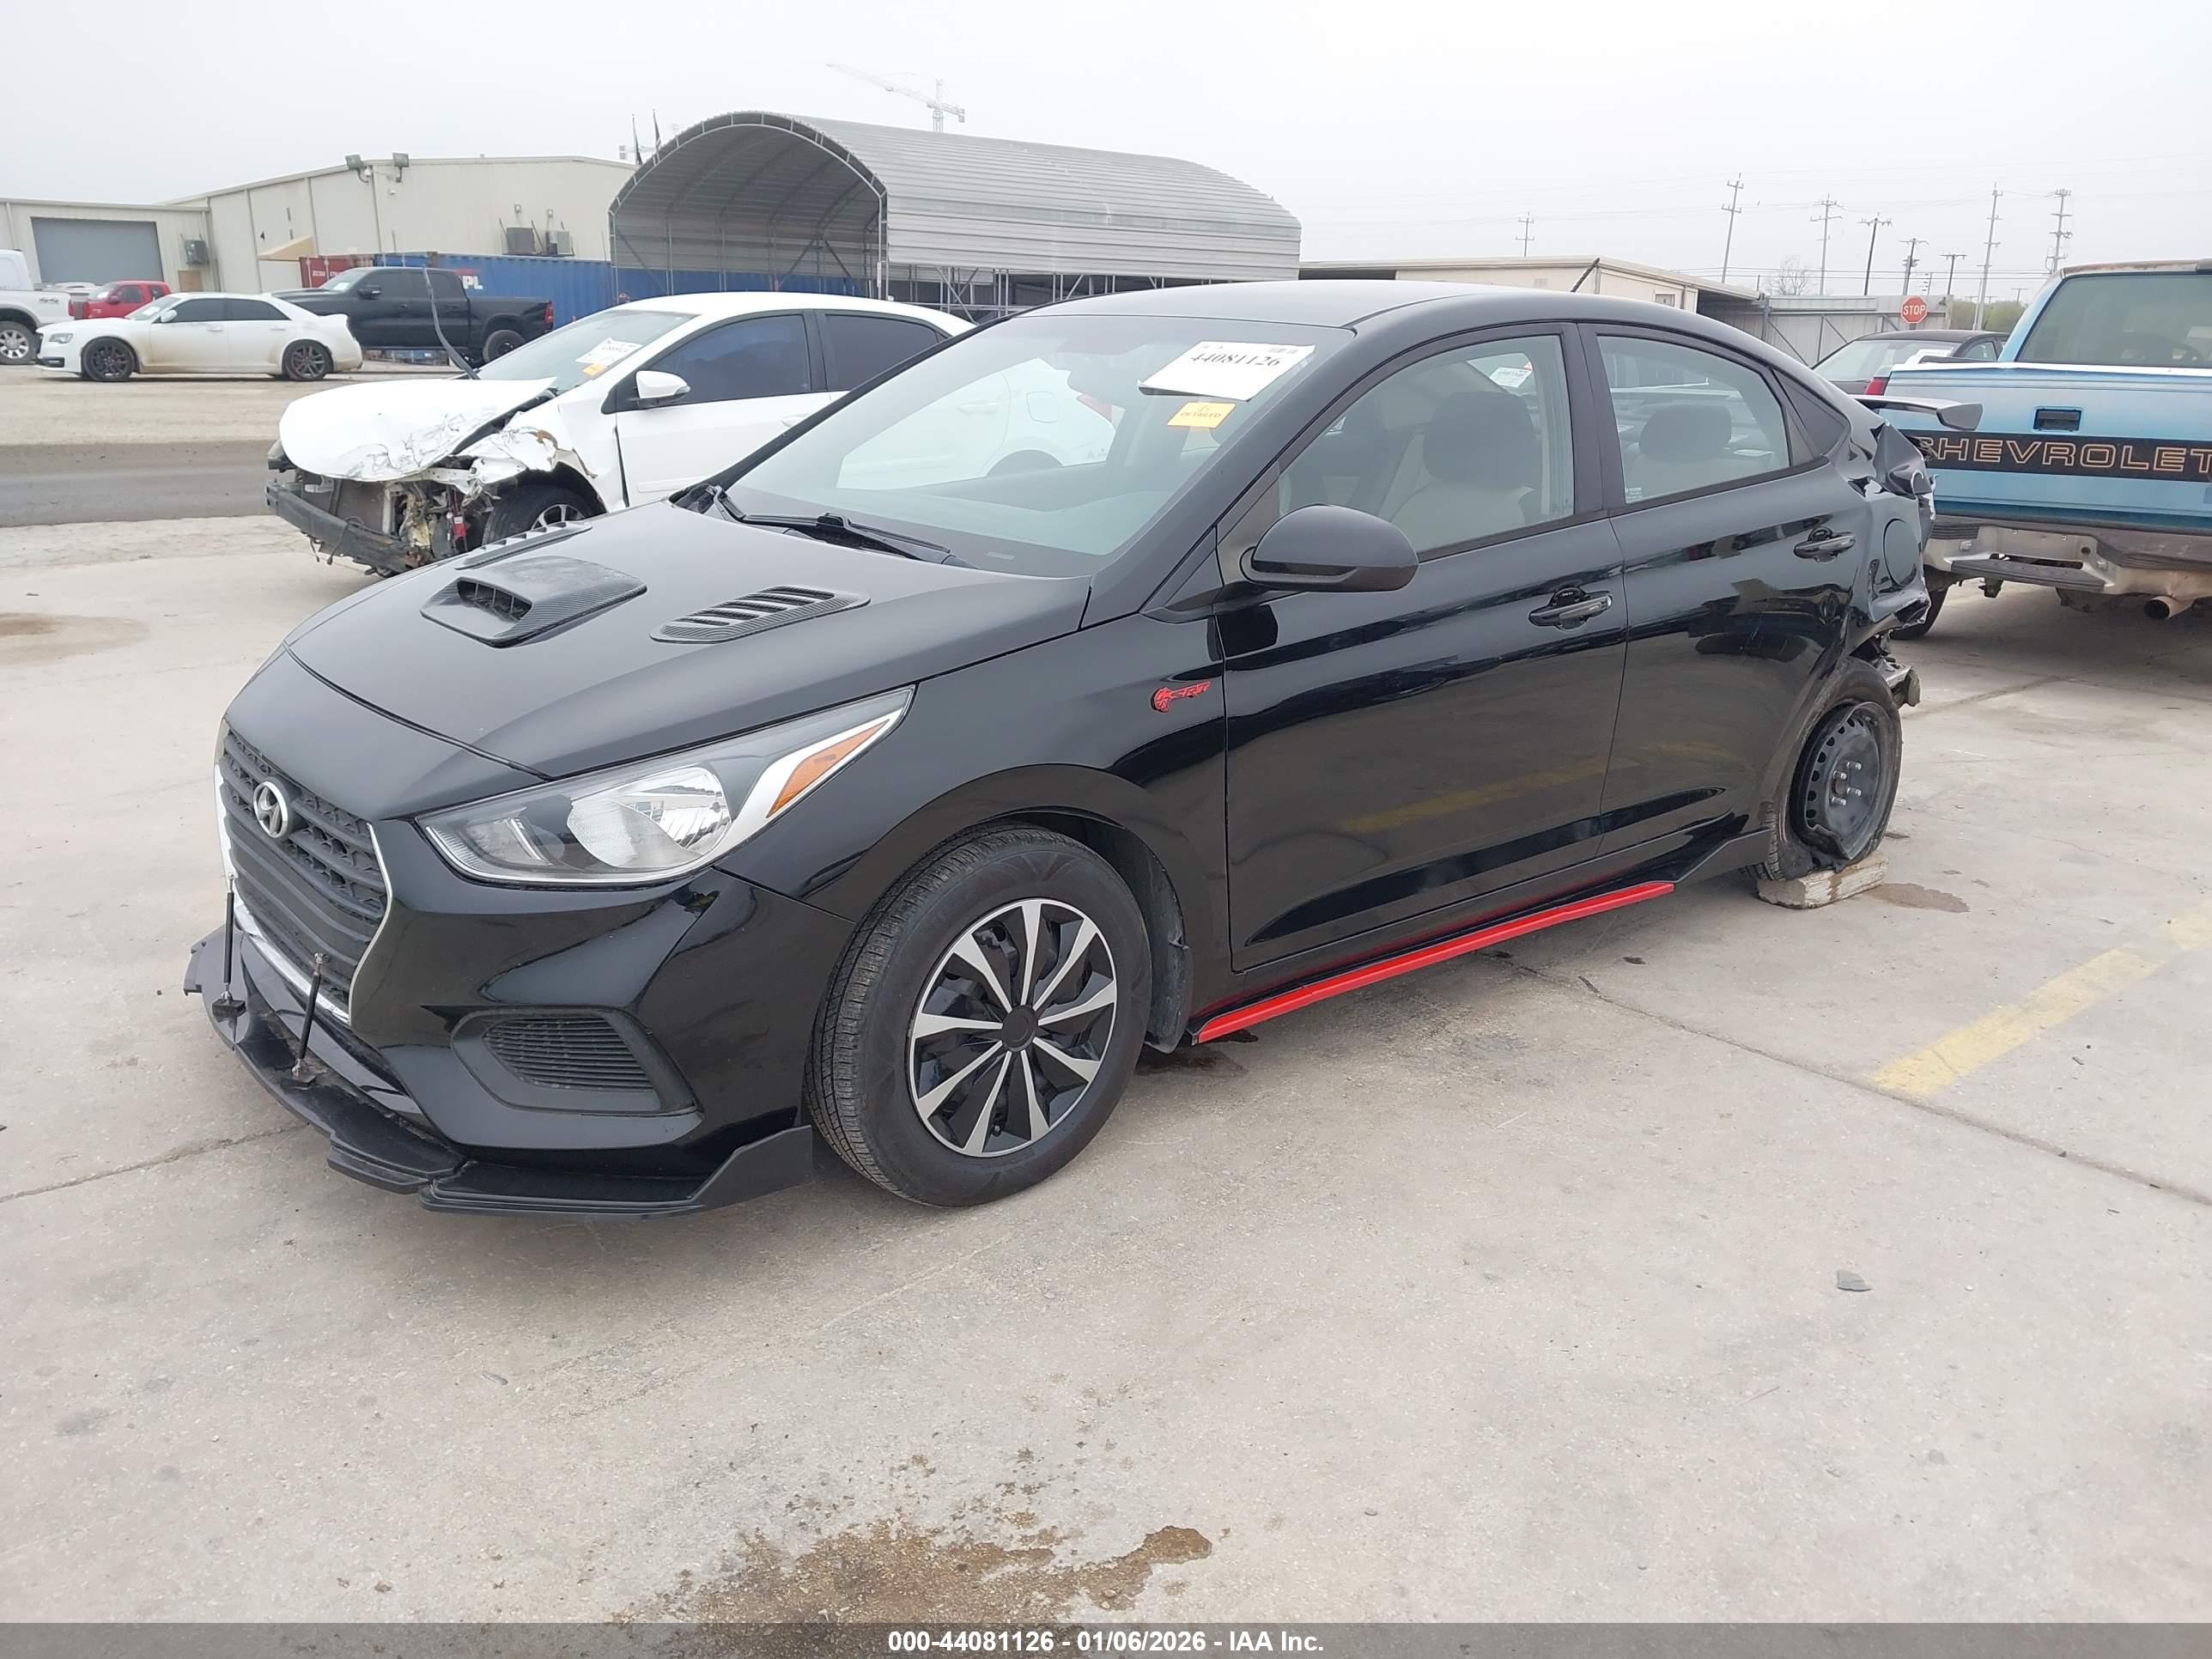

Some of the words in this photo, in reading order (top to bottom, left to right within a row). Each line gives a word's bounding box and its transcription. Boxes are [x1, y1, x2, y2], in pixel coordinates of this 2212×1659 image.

[459, 274, 483, 289] PL
[1903, 304, 1927, 316] STOP
[1189, 352, 1280, 367] 44081126
